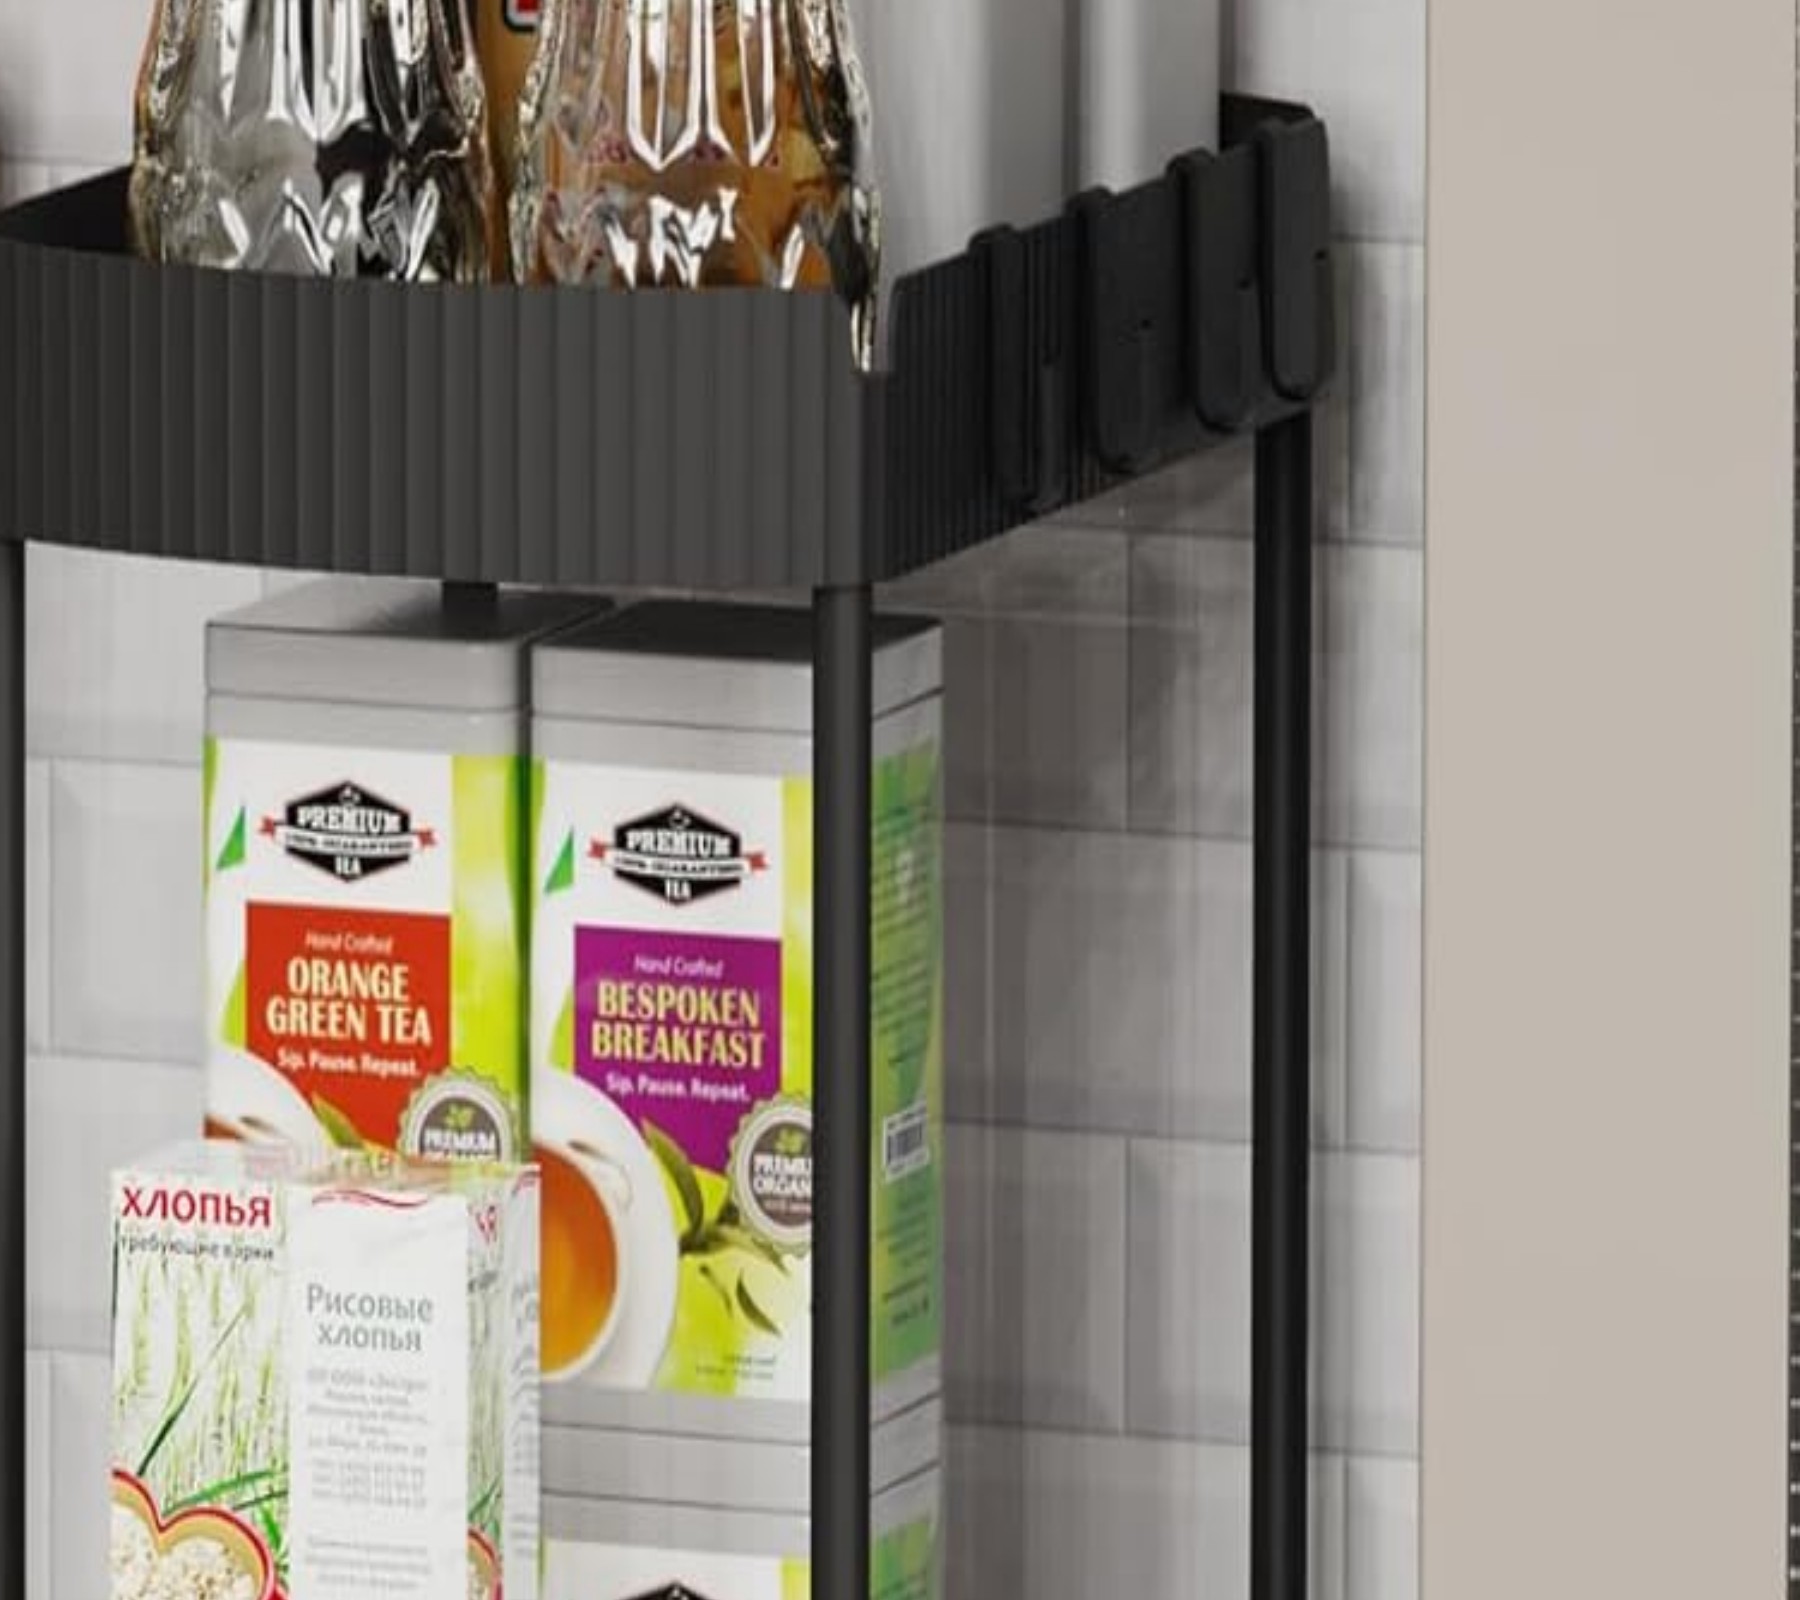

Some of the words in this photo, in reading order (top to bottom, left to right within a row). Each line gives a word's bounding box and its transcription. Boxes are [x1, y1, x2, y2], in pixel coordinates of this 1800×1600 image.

[296, 804, 401, 834] PREMIUM
[626, 828, 731, 857] PREMIUM
[334, 855, 362, 875] TEA
[663, 879, 692, 899] TEA
[304, 929, 342, 951] Hand
[344, 931, 395, 955] Crafted
[287, 956, 410, 1003] ORANGE
[634, 953, 672, 976] Hand
[673, 956, 724, 981] Crafted
[597, 978, 760, 1028] BESPOKEN
[266, 997, 367, 1042] GREEN
[376, 1005, 433, 1047] TEA
[591, 1019, 767, 1070] BREAKFAST
[277, 1047, 306, 1073] Sip.
[308, 1049, 358, 1074] Pause.
[360, 1053, 422, 1080] Repeat.
[605, 1072, 635, 1097] Sip.
[637, 1075, 688, 1098] Pause.
[690, 1080, 752, 1104] Repeat.
[753, 1153, 813, 1176] PREMIU
[752, 1175, 813, 1199] ORGAN
[121, 1185, 272, 1229] ХЛОПЬЯ
[306, 1282, 434, 1323] Рисовые
[317, 1322, 423, 1353] хлопья
